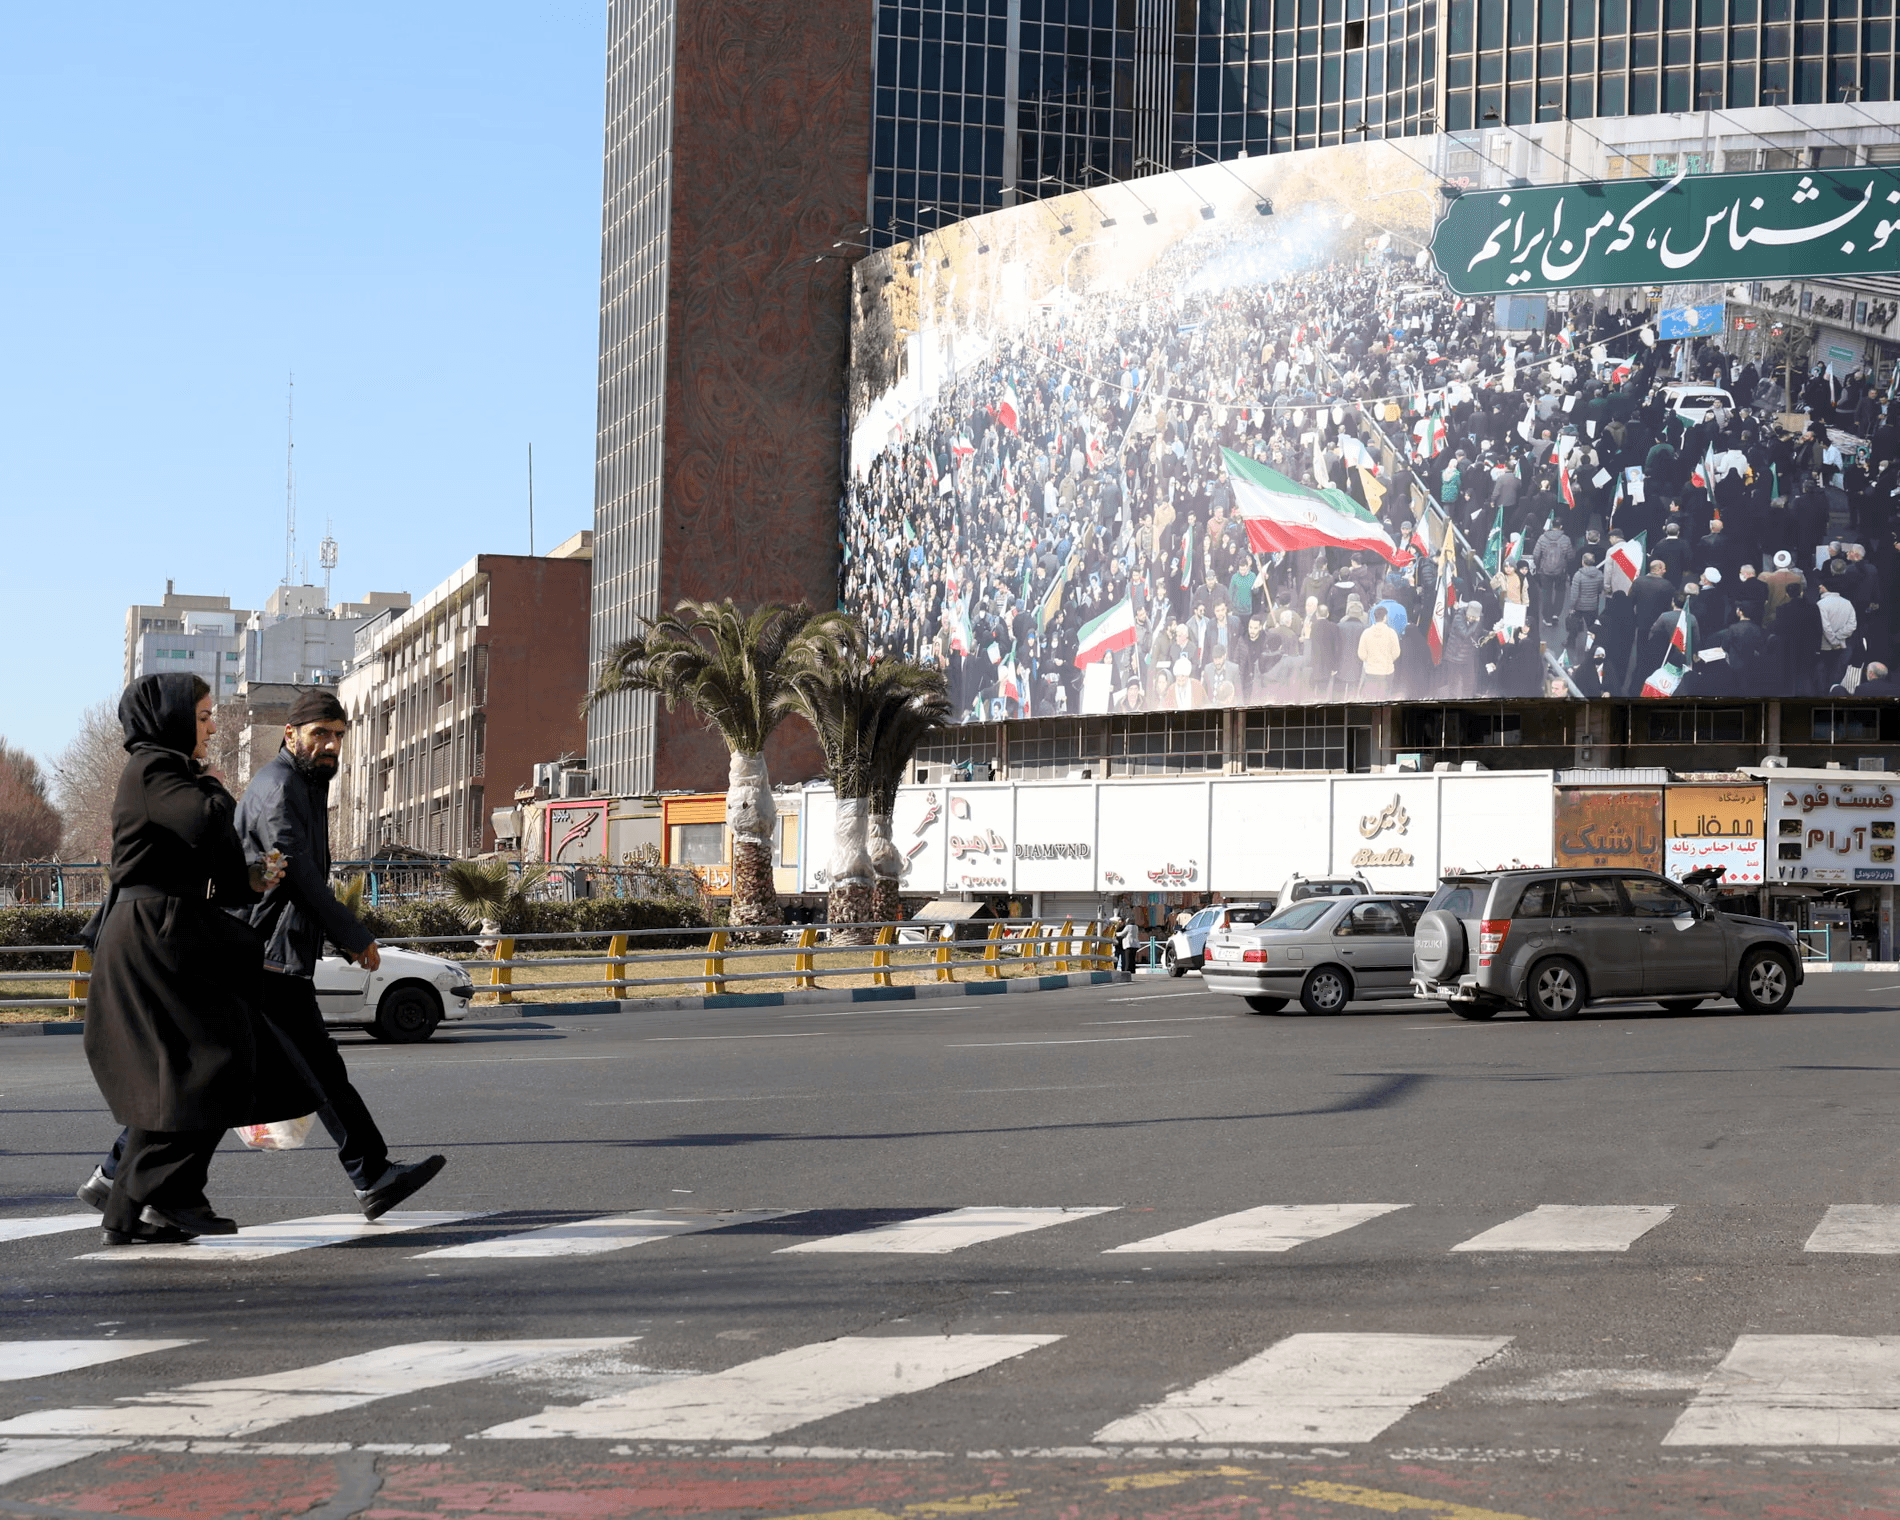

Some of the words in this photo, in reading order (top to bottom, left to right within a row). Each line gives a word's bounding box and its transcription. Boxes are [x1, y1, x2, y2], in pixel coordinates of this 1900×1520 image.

[1606, 169, 1687, 256] که
[1540, 211, 1615, 281] من
[1718, 792, 1757, 804] فروشگاه
[1782, 784, 1829, 813] فود
[1834, 784, 1894, 809] فست
[1359, 793, 1410, 839] بالین
[1672, 841, 1695, 856] زنانه
[1699, 841, 1733, 855] اجناس
[1737, 842, 1758, 855] کلیه
[1806, 827, 1867, 854] آرام
[1352, 847, 1412, 867] Balin
[1416, 940, 1442, 948] SUZUKI
